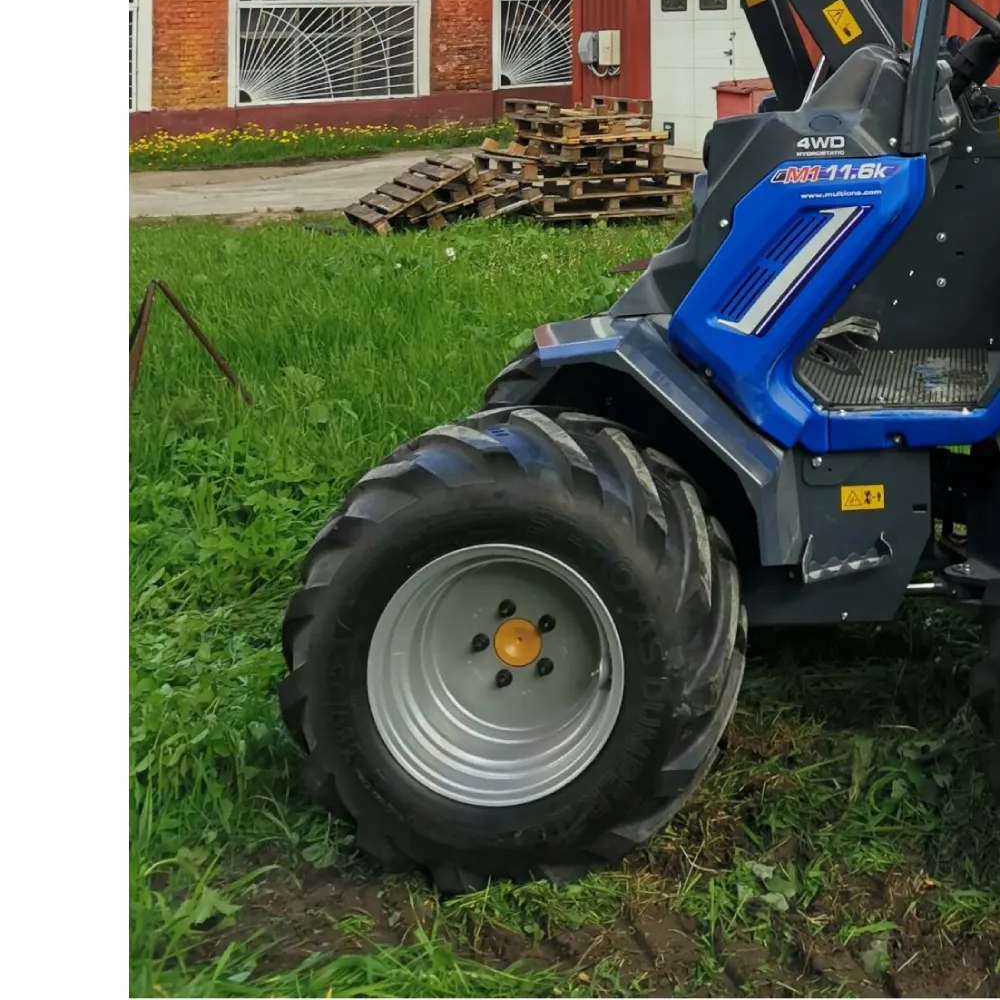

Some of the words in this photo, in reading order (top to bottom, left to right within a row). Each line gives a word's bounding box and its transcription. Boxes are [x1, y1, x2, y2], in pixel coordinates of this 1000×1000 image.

[796, 136, 845, 149] 4WD
[783, 165, 821, 185] M1
[827, 162, 886, 181] 11.6k
[800, 189, 882, 200] www.multione.com
